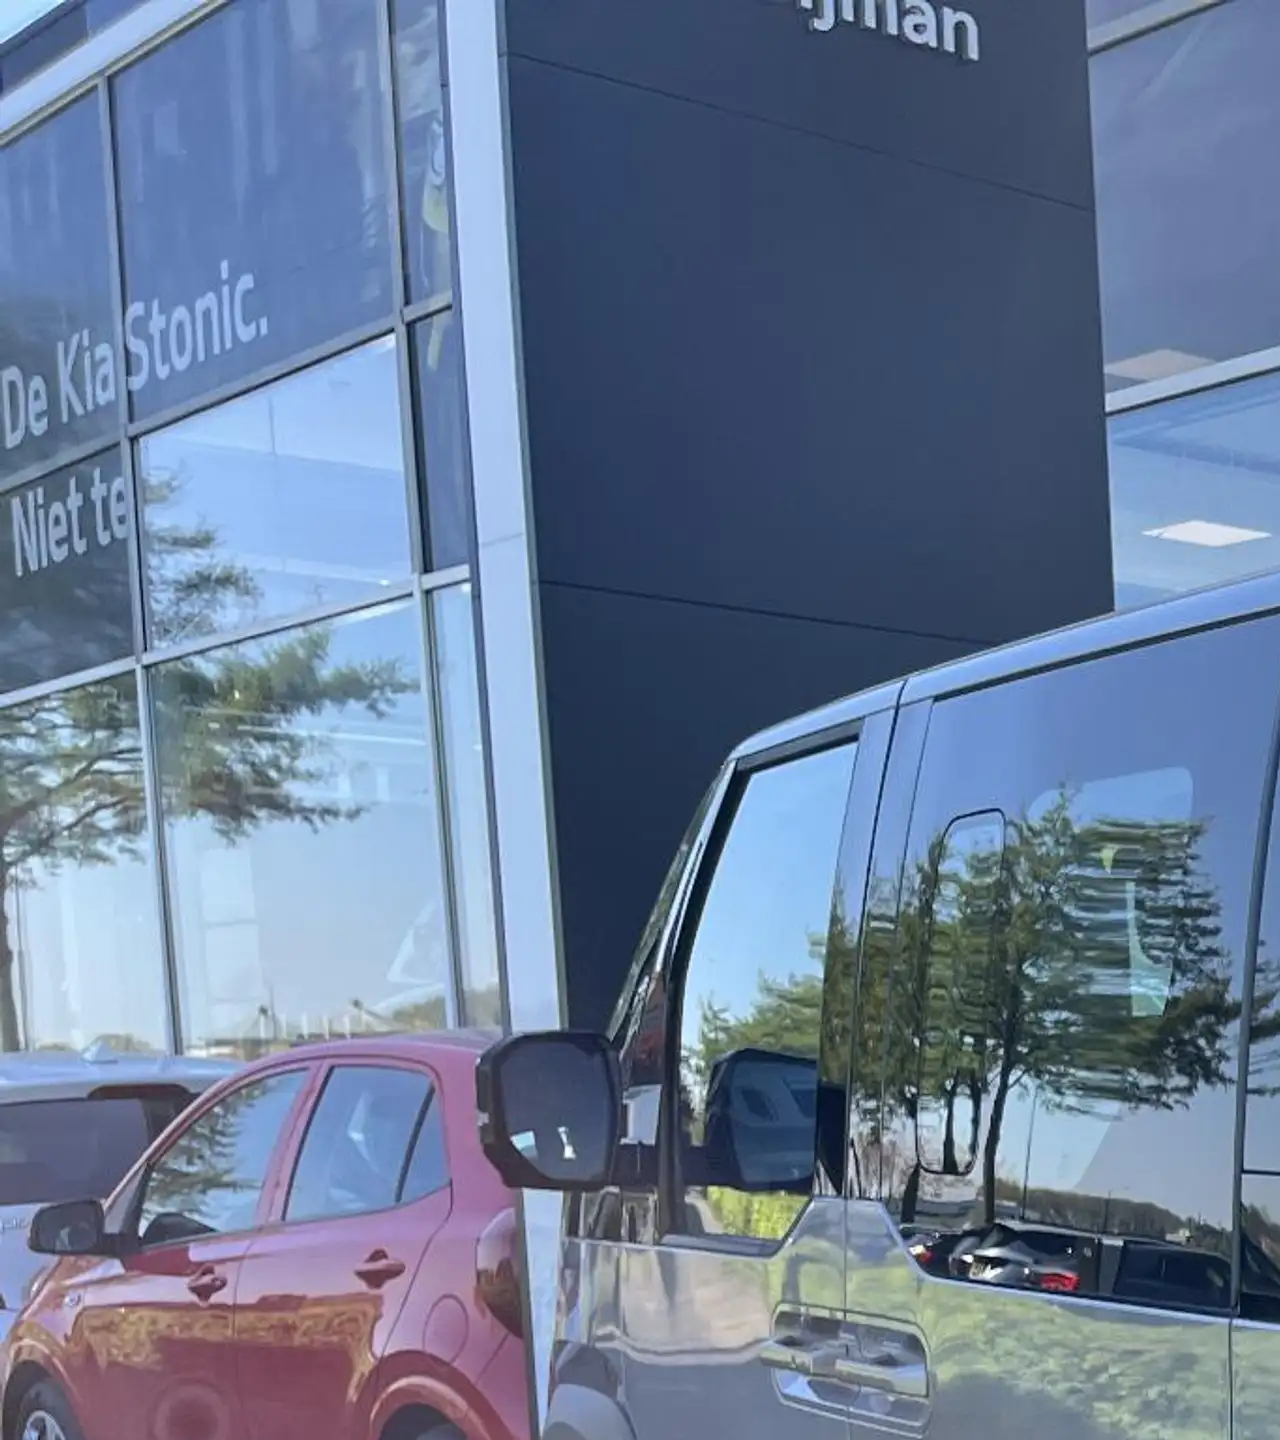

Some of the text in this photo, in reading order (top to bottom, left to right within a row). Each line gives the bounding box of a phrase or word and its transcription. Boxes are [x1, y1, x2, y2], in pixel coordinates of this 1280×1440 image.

[1, 259, 269, 450] De Kia Stonic.
[11, 475, 87, 578] Niet
